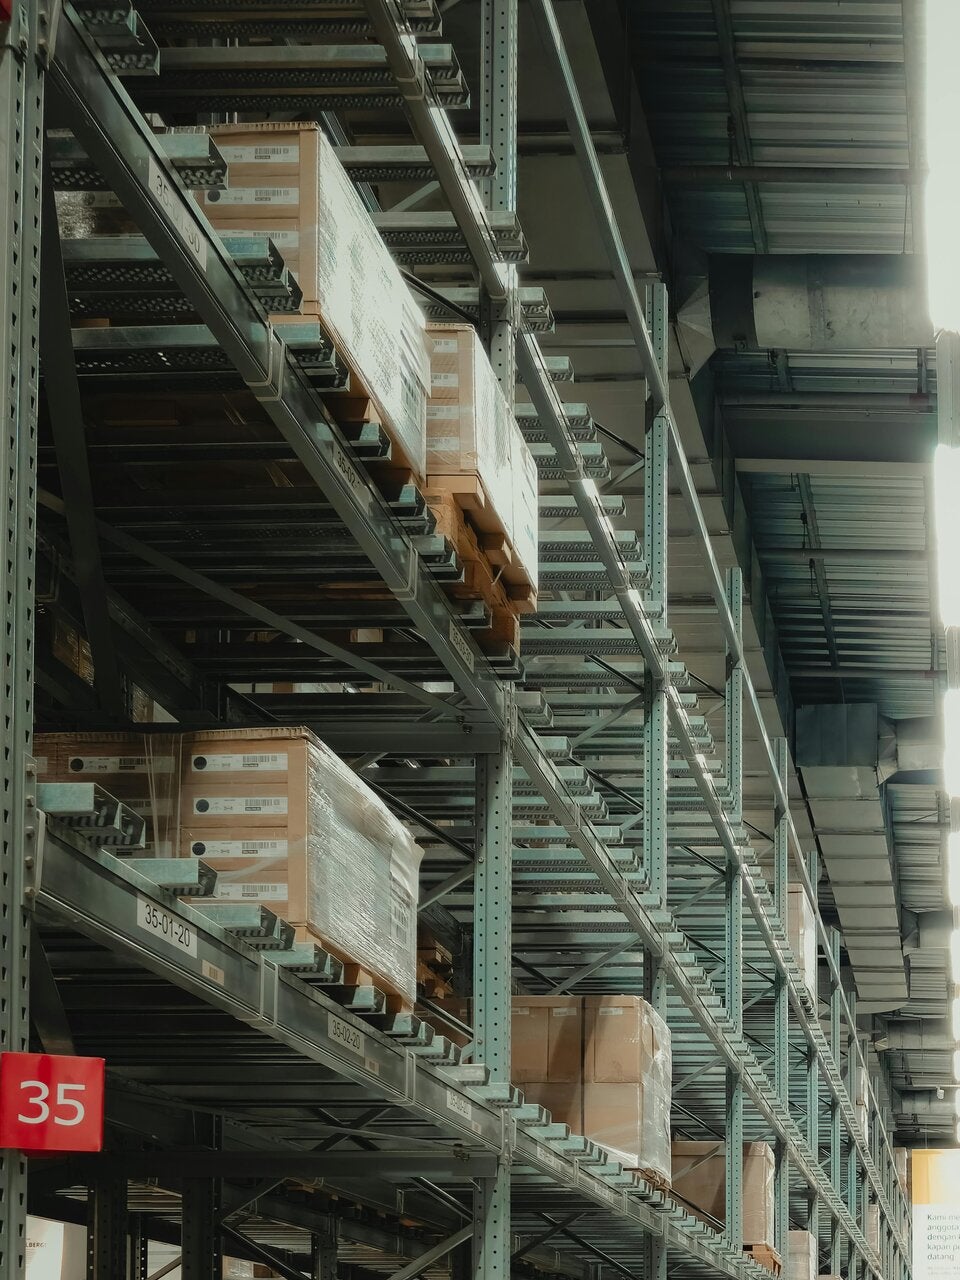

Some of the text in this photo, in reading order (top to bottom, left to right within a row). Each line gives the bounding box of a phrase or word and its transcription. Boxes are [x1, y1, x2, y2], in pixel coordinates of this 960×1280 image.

[145, 904, 190, 947] 35-01-20
[332, 1019, 361, 1050] 35-02-20
[18, 1080, 86, 1126] 35
[927, 1223, 959, 1232] anggota
[927, 1234, 956, 1242] dengan
[927, 1243, 951, 1251] kapan
[927, 1253, 954, 1261] datang
